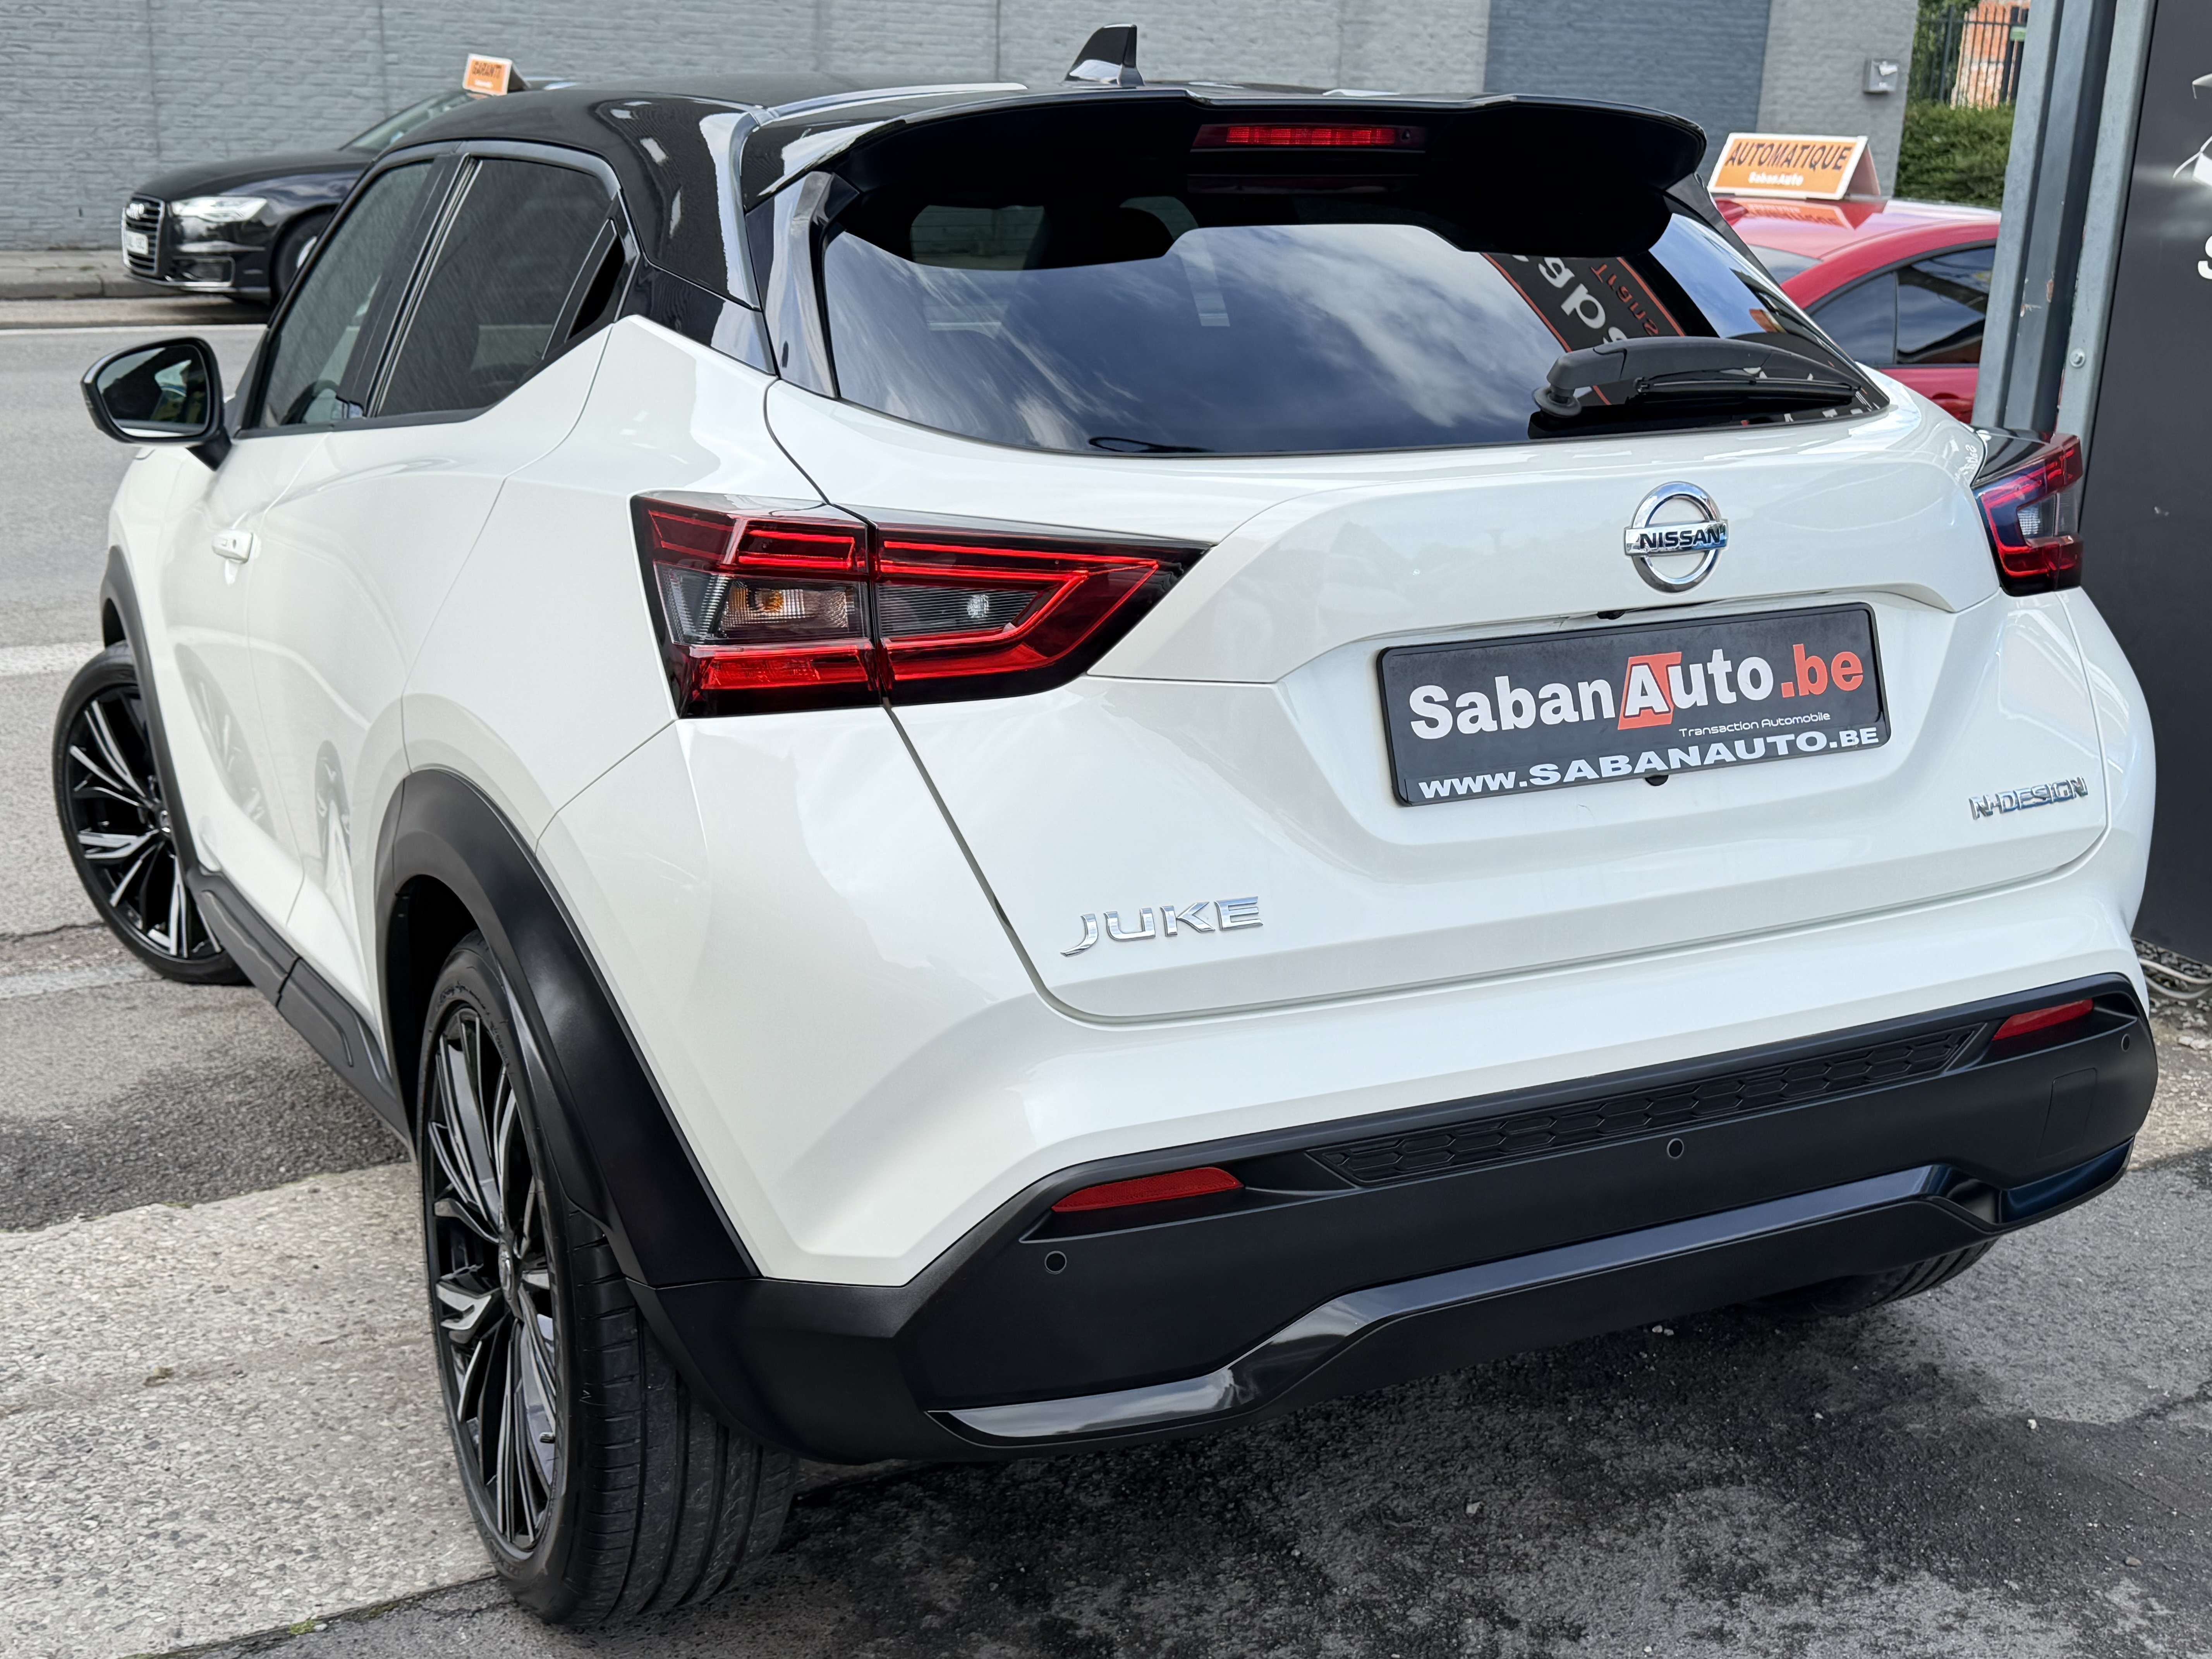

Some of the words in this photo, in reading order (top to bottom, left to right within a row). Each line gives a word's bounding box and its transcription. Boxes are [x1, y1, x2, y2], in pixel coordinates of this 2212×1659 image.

[1725, 141, 1851, 172] AUTOMATIQUE
[1640, 527, 1720, 549] NISSAN
[1409, 643, 1863, 739] SabanAuto.be
[1679, 721, 1759, 738] Transaction
[1761, 712, 1831, 727] Automobile
[1419, 727, 1879, 799] www.SABANAUTO.BE
[1968, 775, 2088, 820] N-DESIGN
[1060, 896, 1263, 958] JUKE
